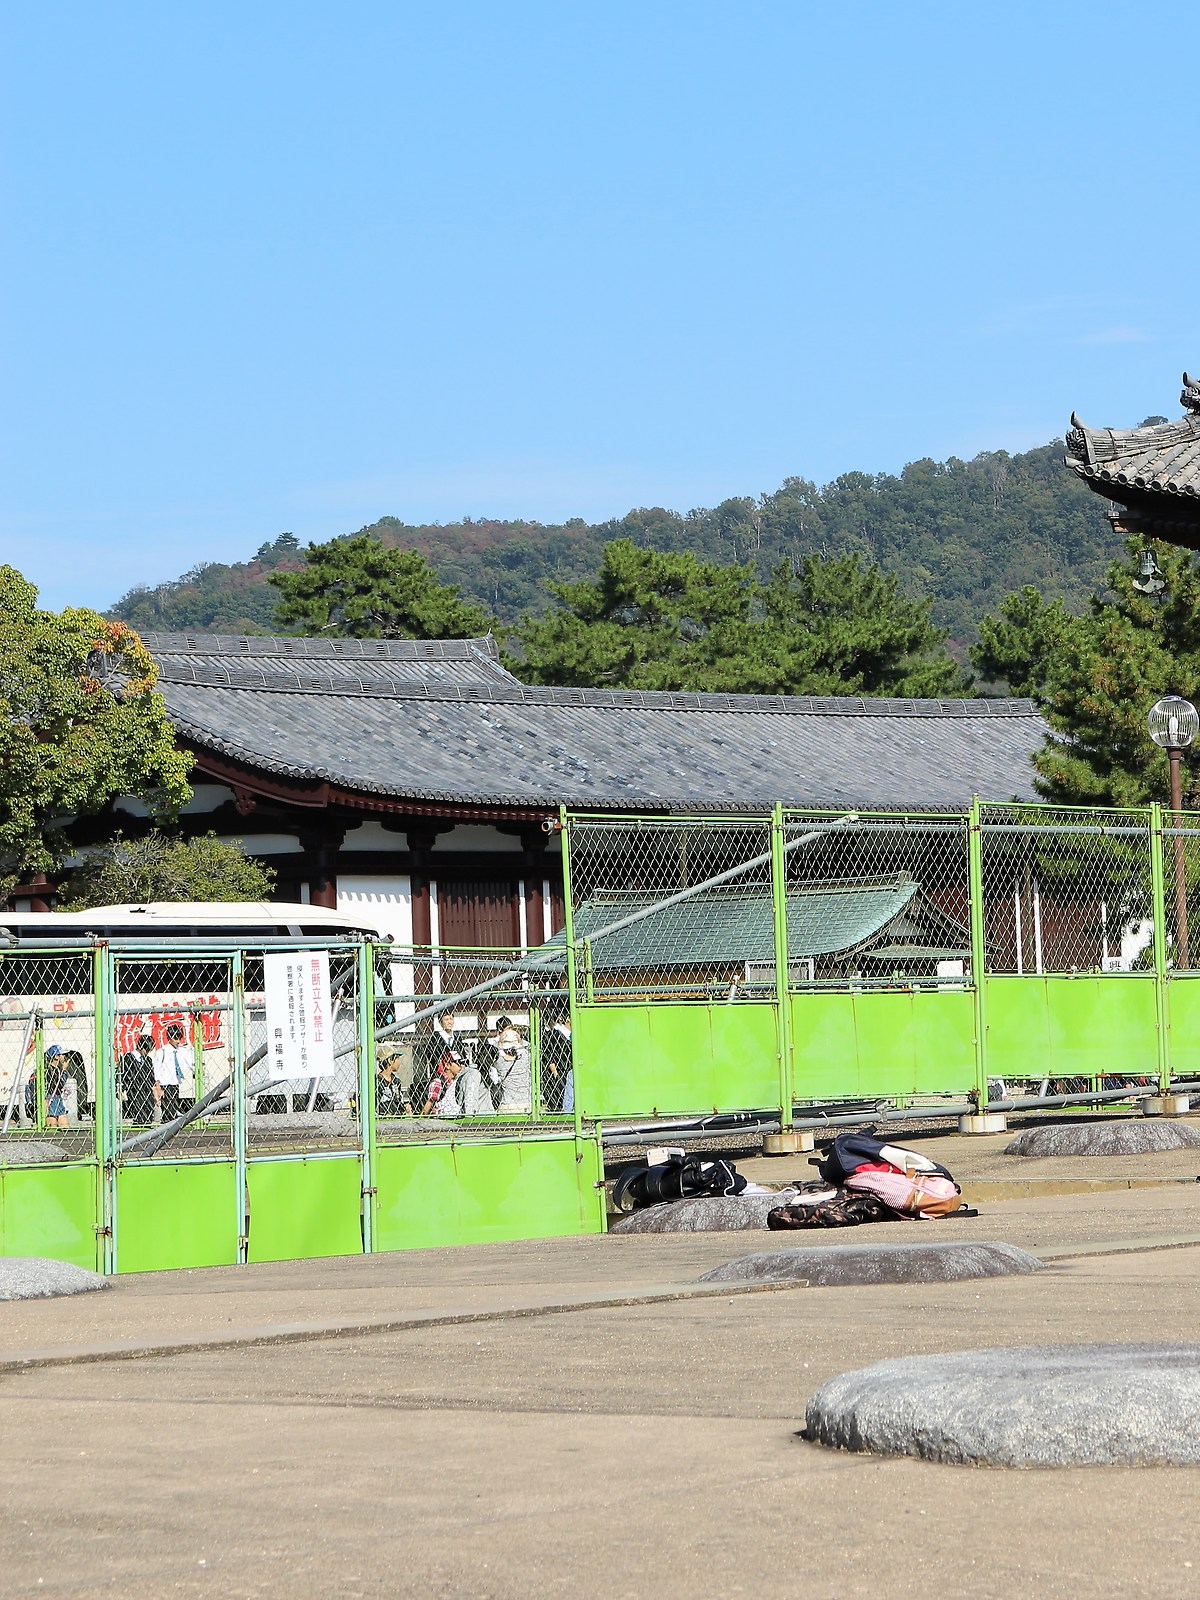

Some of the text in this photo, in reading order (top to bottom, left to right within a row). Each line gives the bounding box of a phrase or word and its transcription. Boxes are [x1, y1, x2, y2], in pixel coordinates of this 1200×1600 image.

[311, 959, 323, 1042] 無断立入禁止
[275, 1028, 284, 1070] 興福寺
